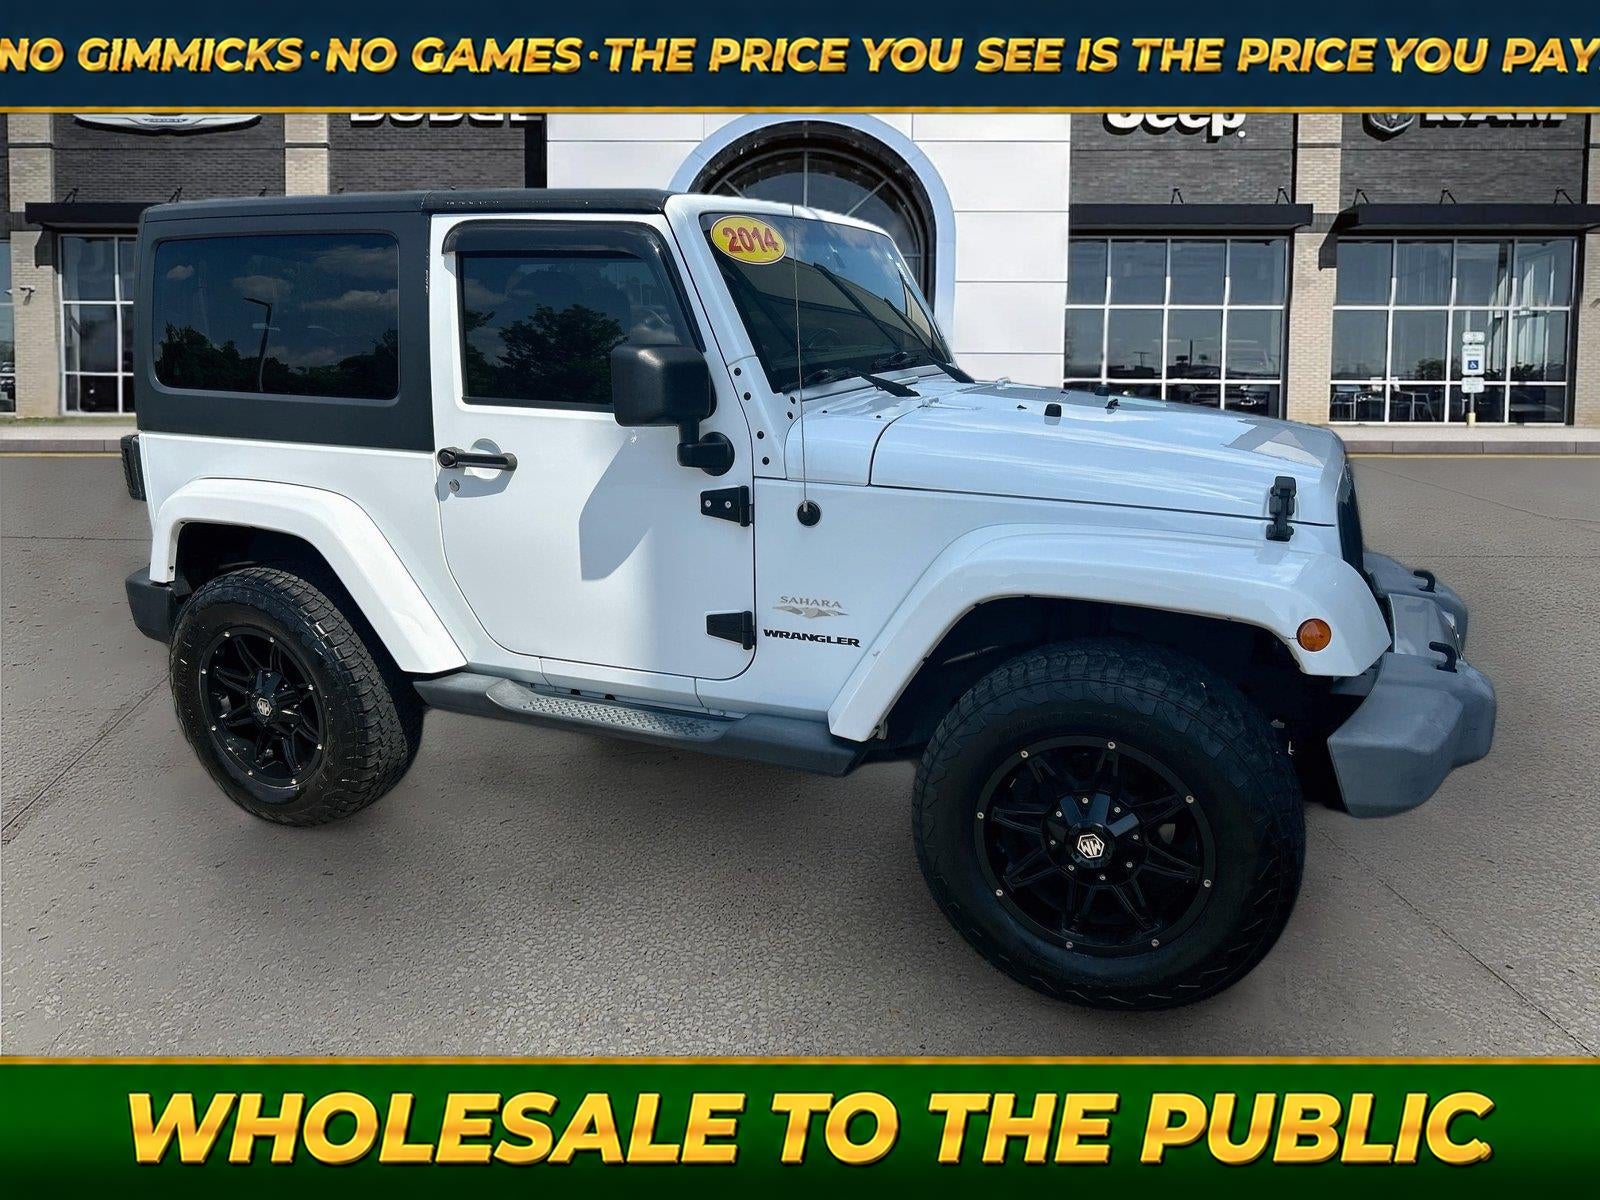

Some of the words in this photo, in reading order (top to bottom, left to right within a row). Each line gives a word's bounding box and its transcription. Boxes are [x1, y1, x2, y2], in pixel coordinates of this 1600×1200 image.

[722, 226, 780, 253] 2014
[780, 595, 843, 609] SAHARA
[763, 628, 861, 648] WRANGLER
